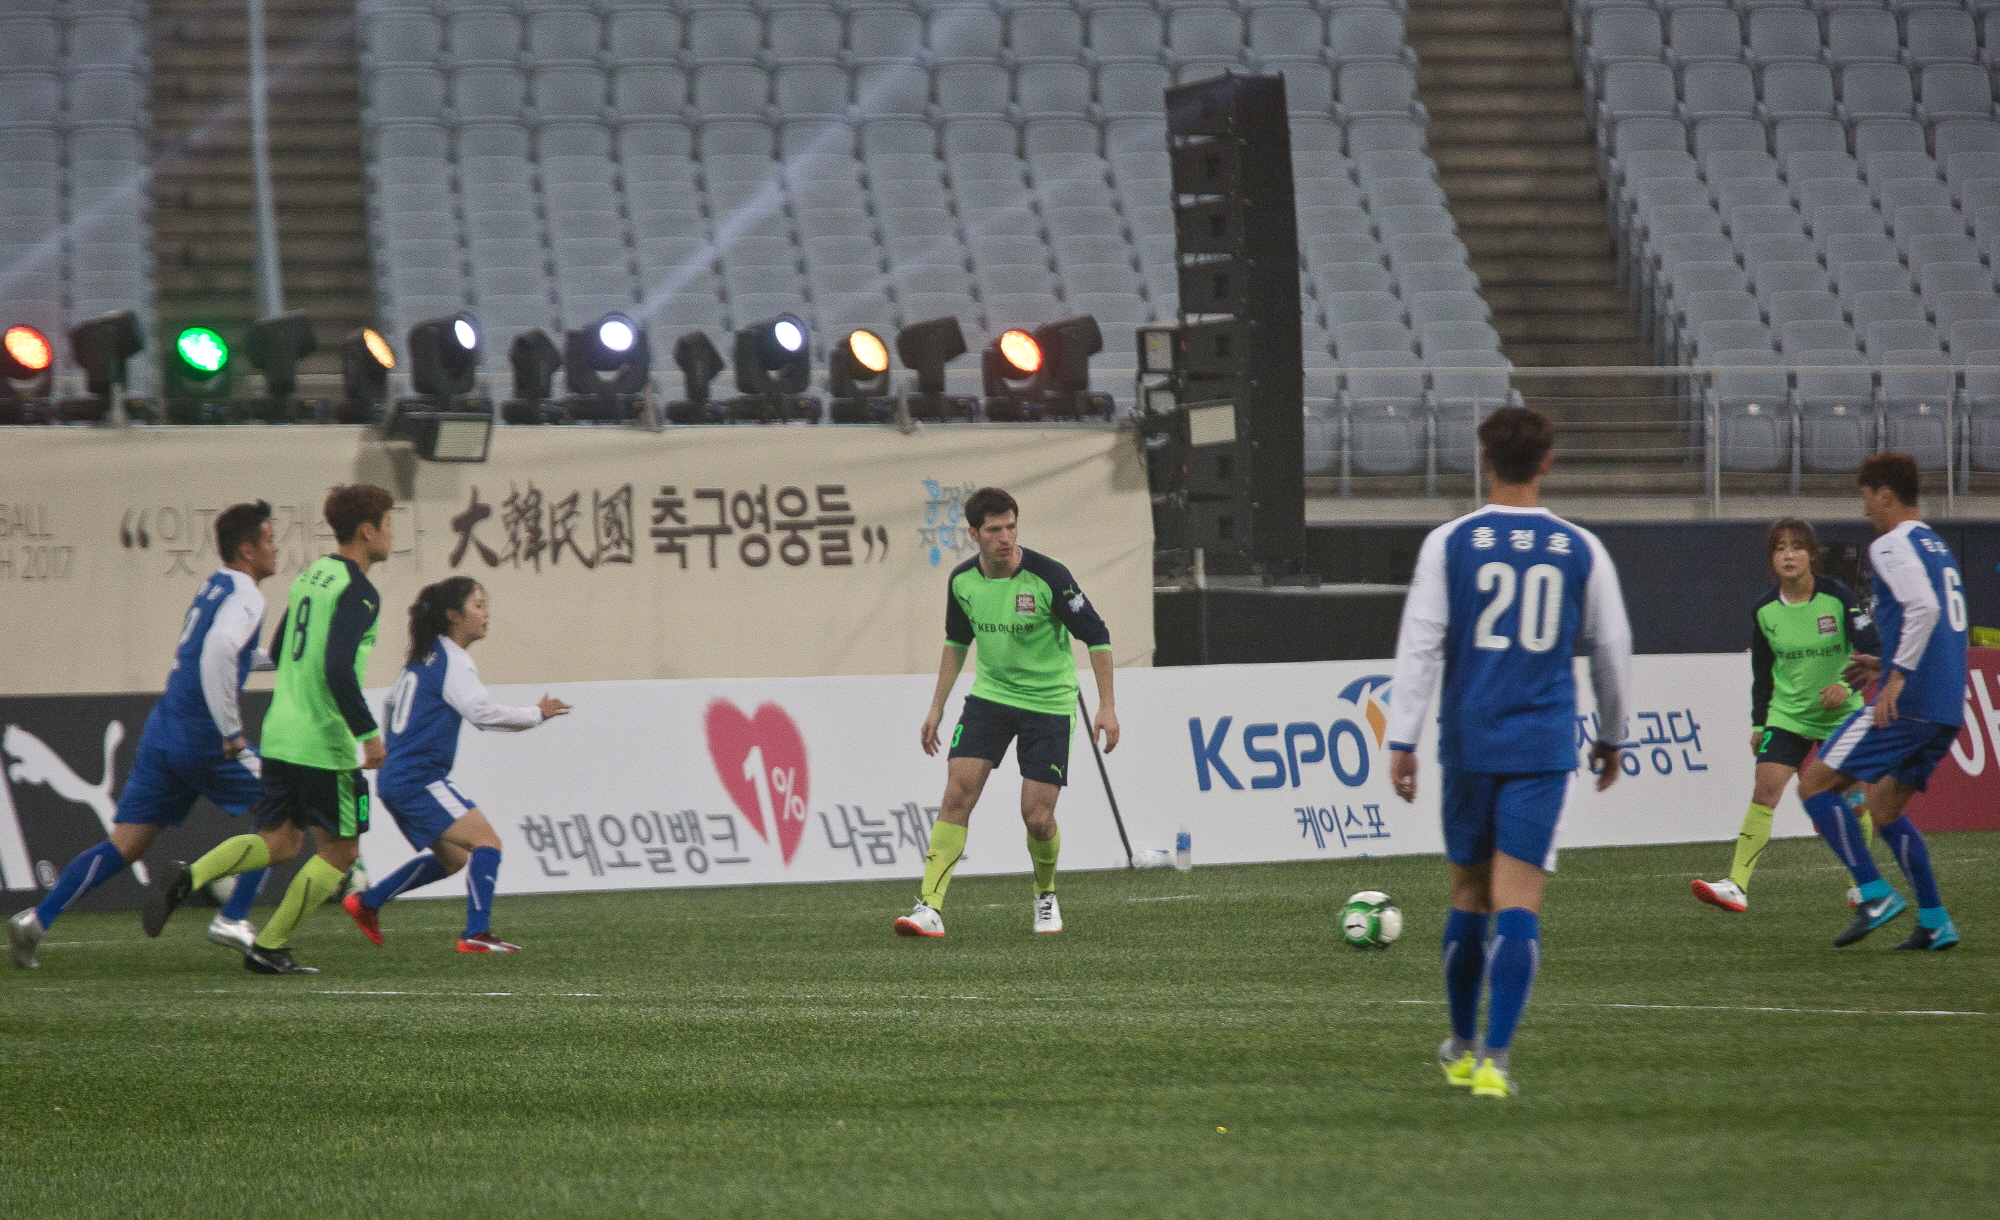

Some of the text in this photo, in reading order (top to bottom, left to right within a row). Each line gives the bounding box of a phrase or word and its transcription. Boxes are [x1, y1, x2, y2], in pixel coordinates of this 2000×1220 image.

[449, 480, 635, 573] 大韓民國
[292, 596, 312, 662] 8
[1474, 561, 1565, 652] 20
[1943, 566, 1968, 633] 6
[1188, 715, 1371, 792] KSPO
[1759, 730, 1773, 753] 2
[358, 794, 369, 822] 8
[741, 745, 805, 869] 1%
[1294, 803, 1392, 849] 케이스포
[519, 808, 751, 877] 현대오일뱅크
